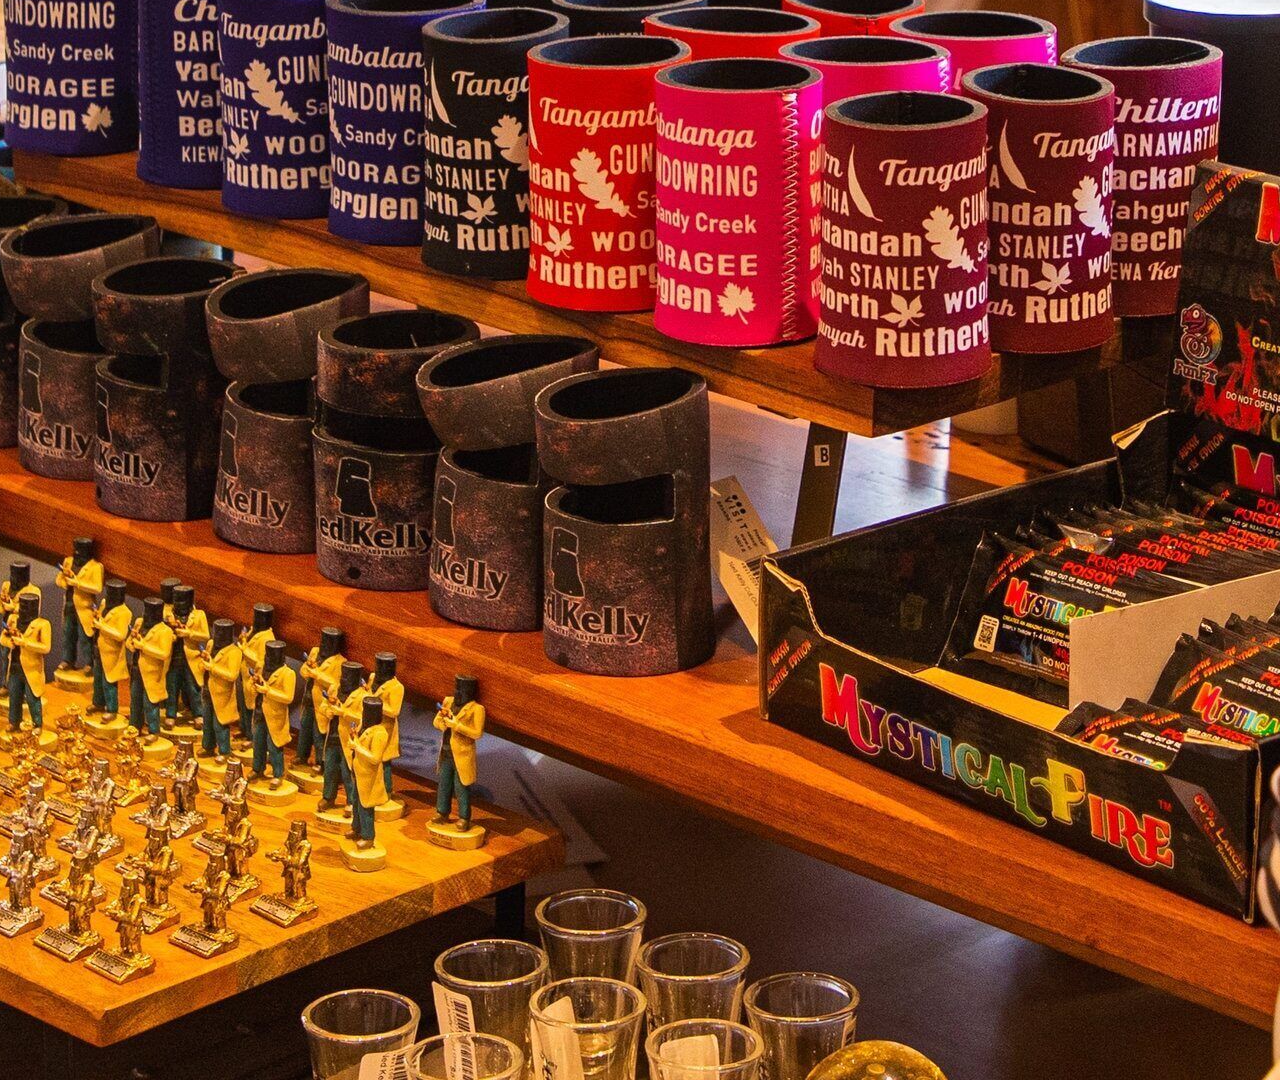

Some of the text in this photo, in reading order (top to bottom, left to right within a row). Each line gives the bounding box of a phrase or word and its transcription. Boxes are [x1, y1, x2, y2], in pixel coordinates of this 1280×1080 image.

[13, 38, 115, 65] Sandy Creek
[345, 124, 397, 151] Sandy
[436, 162, 509, 191] STANLEY
[695, 212, 758, 234] Creek
[999, 233, 1086, 259] STANLEY
[850, 265, 940, 290] STANLEY
[1225, 390, 1237, 401] DO
[1238, 395, 1254, 407] NOT
[1254, 399, 1275, 413] OPEN
[25, 417, 96, 460] Kelly
[97, 444, 162, 488] Kelly
[820, 447, 829, 463] B
[220, 478, 291, 528] Kelly
[724, 494, 749, 530] VISIT
[350, 519, 432, 555] Kelly
[367, 547, 409, 557] AUSTRALIA
[1137, 539, 1192, 564] POISON
[436, 546, 509, 601] Kelly
[1044, 569, 1127, 597] KEEP REACH CHILDREN
[1061, 561, 1118, 587] POISON
[560, 597, 651, 646] Kelly
[576, 632, 616, 645] AUSTRALIA
[1042, 657, 1053, 667] DO
[1241, 677, 1255, 685] KEEP
[818, 662, 1047, 827] MYSTICAL
[1030, 757, 1175, 869] FIRE
